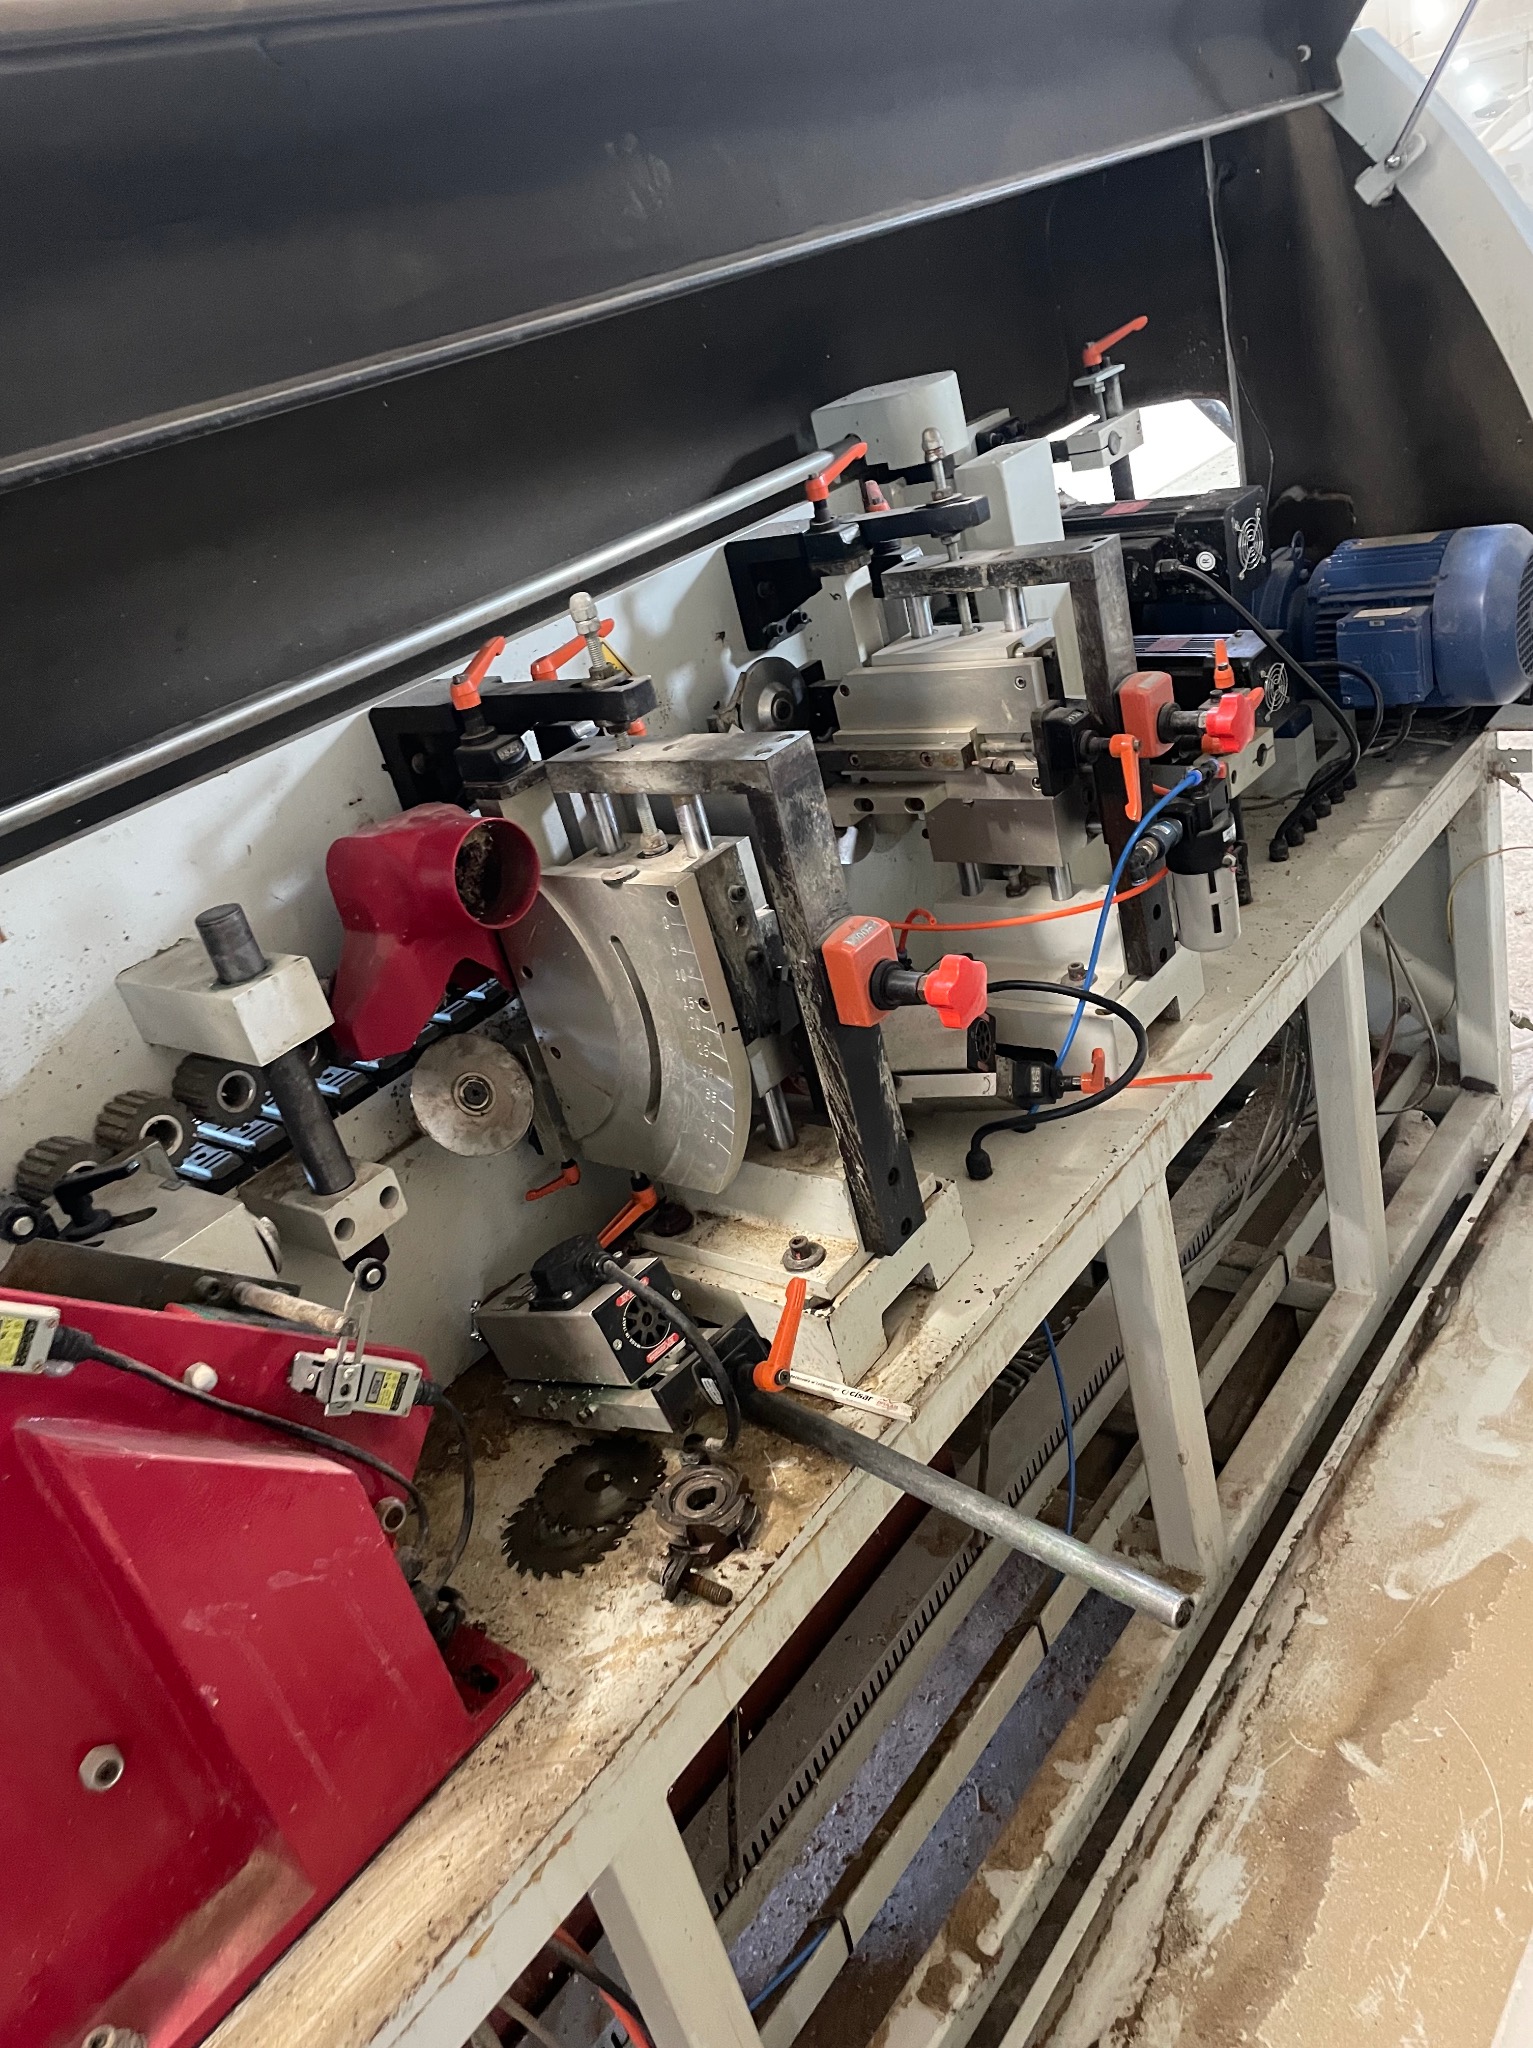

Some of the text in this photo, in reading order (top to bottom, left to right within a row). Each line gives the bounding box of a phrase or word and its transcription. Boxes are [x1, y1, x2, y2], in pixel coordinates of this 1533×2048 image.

[675, 968, 687, 982] 10
[682, 996, 695, 1012] 15
[688, 1016, 701, 1031] 20
[697, 1041, 711, 1058] 25
[849, 1391, 874, 1402] cisar
